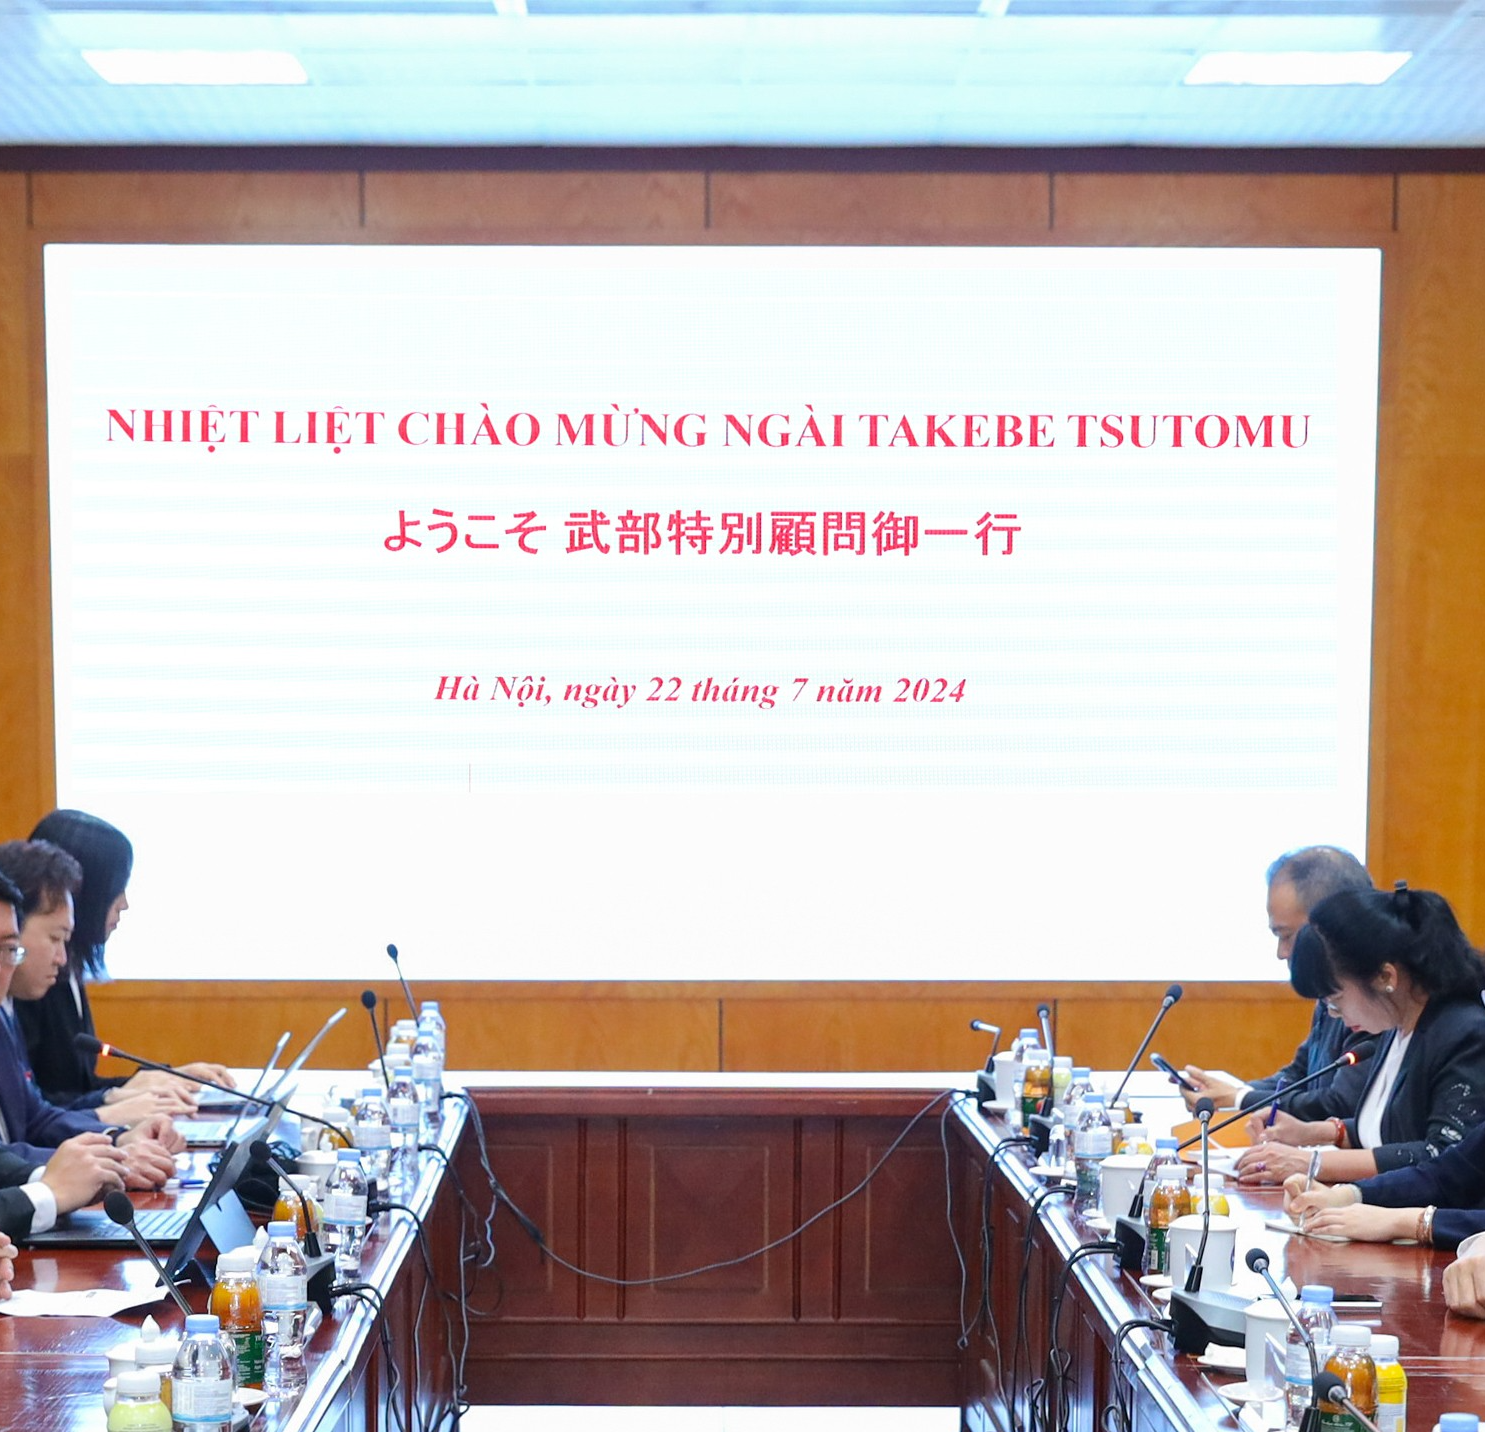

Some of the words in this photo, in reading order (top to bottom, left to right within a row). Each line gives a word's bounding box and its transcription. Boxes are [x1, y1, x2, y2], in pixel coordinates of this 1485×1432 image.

[107, 404, 260, 454] NHIỆT
[274, 405, 386, 455] LIỆT
[397, 402, 541, 447] CHÀO
[556, 402, 708, 448] MỪNG
[723, 404, 844, 448] NGÀI
[858, 413, 1055, 448] TAKEBE
[1067, 413, 1312, 449] TSUTOMU
[383, 507, 547, 556] ようこそ
[563, 508, 1022, 557] 武部特別顧問御一行
[434, 675, 480, 702] Hà
[490, 675, 552, 708] Nội,
[563, 675, 637, 709] ngày
[646, 676, 683, 702] 22
[691, 676, 780, 709] tháng
[791, 677, 810, 702] 7
[816, 678, 884, 704] năm
[892, 677, 967, 703] 2024
